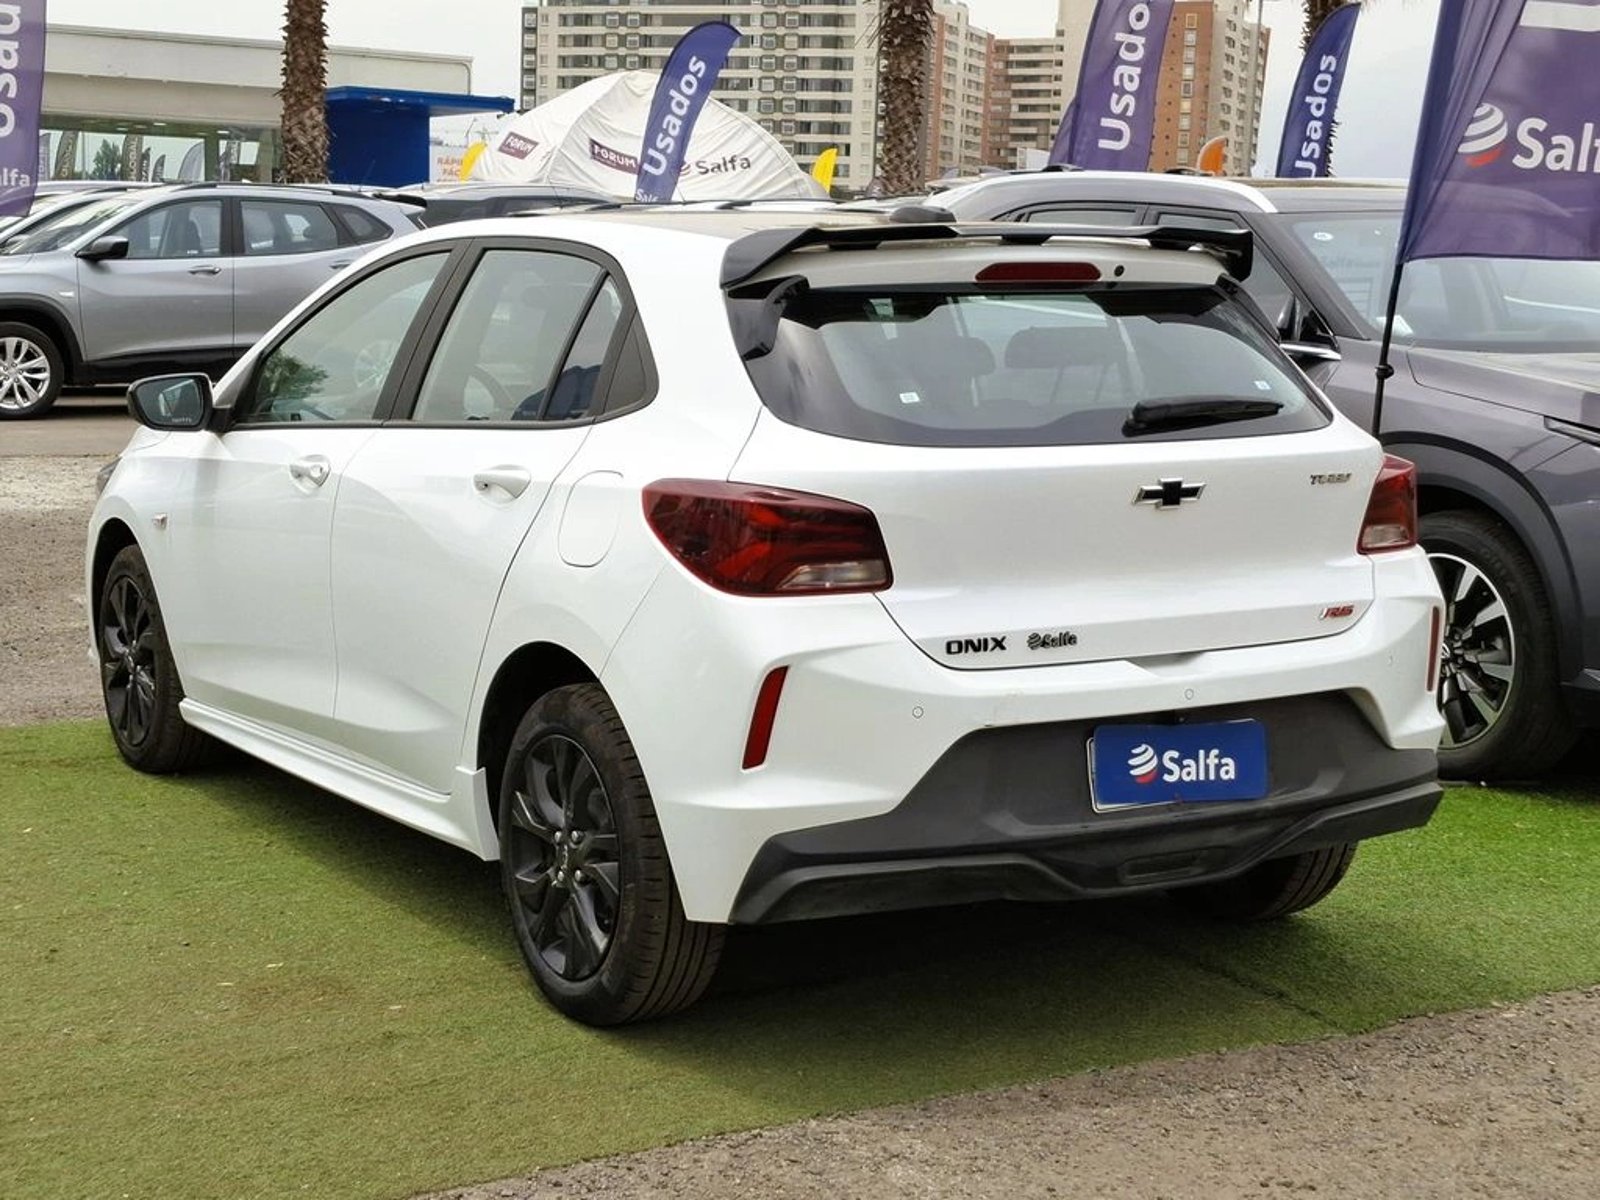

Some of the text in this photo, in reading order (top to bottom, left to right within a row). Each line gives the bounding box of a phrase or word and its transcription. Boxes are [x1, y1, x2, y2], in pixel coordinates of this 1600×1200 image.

[643, 55, 706, 177] Usados
[593, 144, 637, 169] FORUM
[694, 155, 751, 175] Salfa
[0, 168, 31, 187] lfa
[945, 635, 1007, 655] ONIX
[1162, 748, 1236, 783] Salfa
